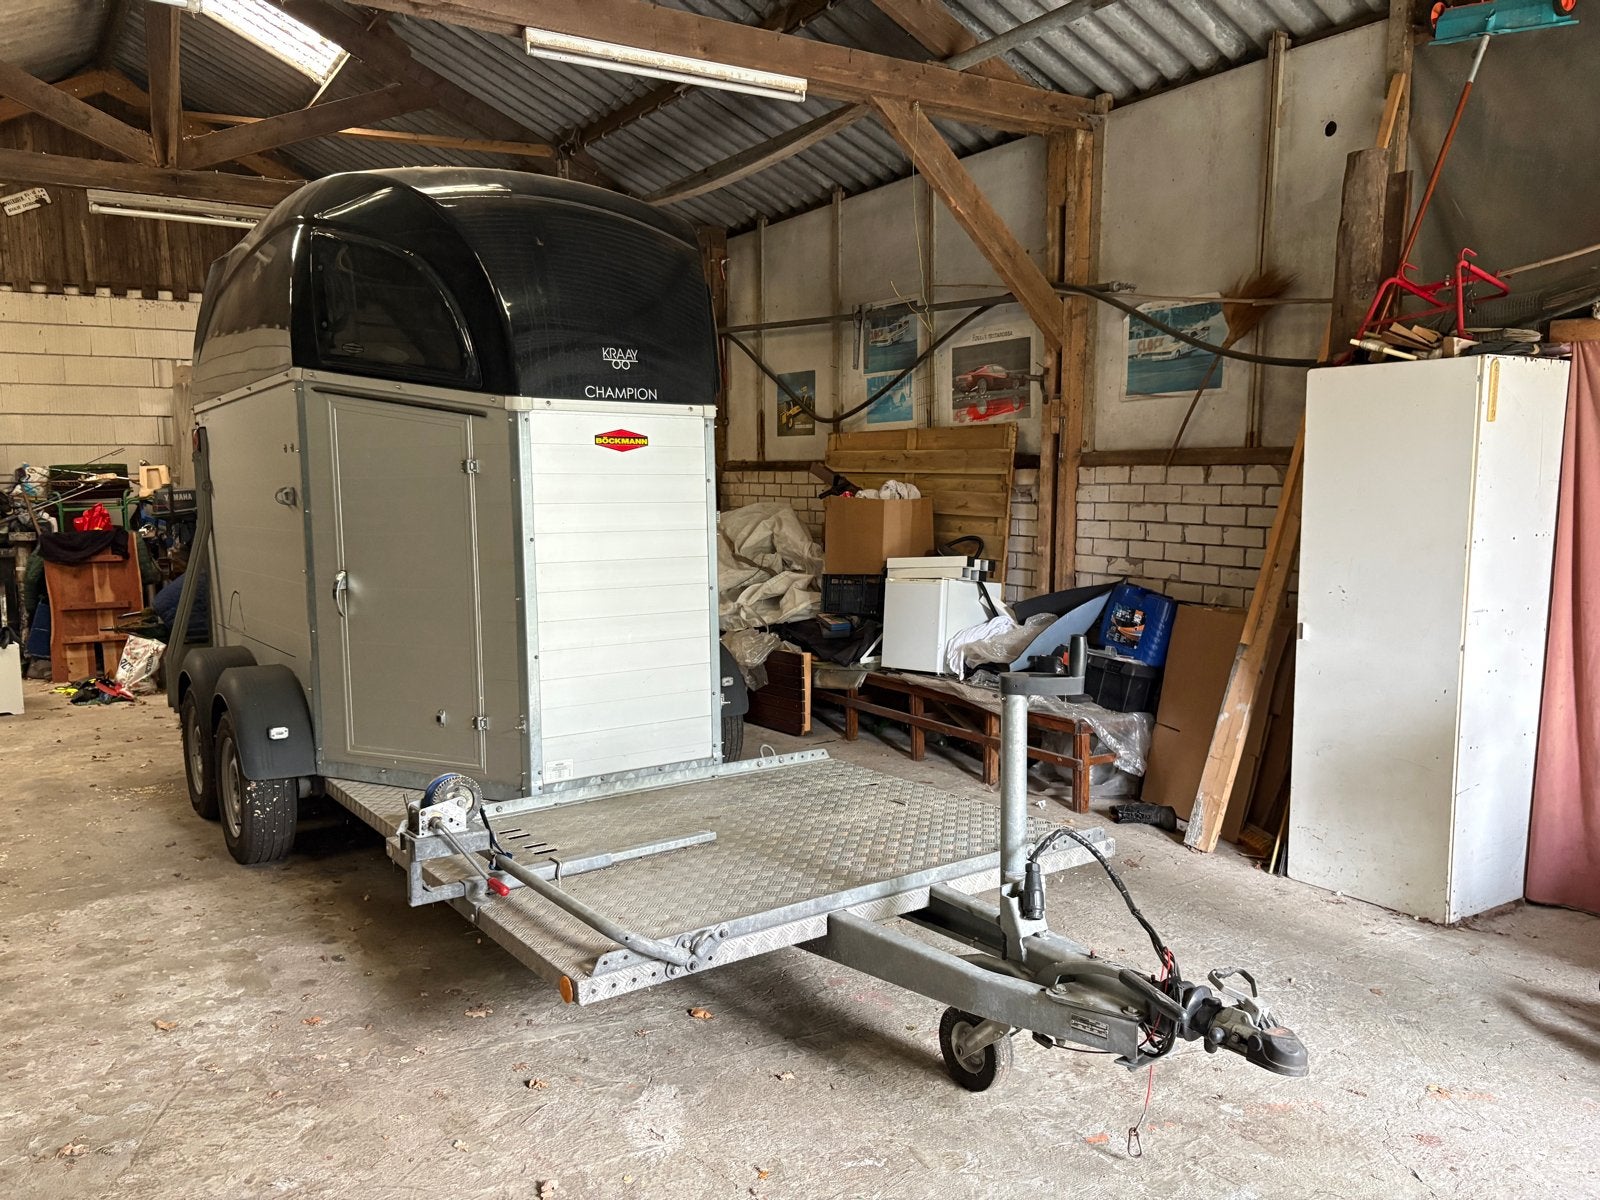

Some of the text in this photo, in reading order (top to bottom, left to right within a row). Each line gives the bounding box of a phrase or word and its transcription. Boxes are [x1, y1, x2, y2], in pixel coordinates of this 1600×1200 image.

[602, 347, 638, 361] KRAAY
[584, 385, 658, 400] CHAMPION
[595, 436, 648, 445] BÖCKMANN
[164, 493, 193, 501] YMAHA
